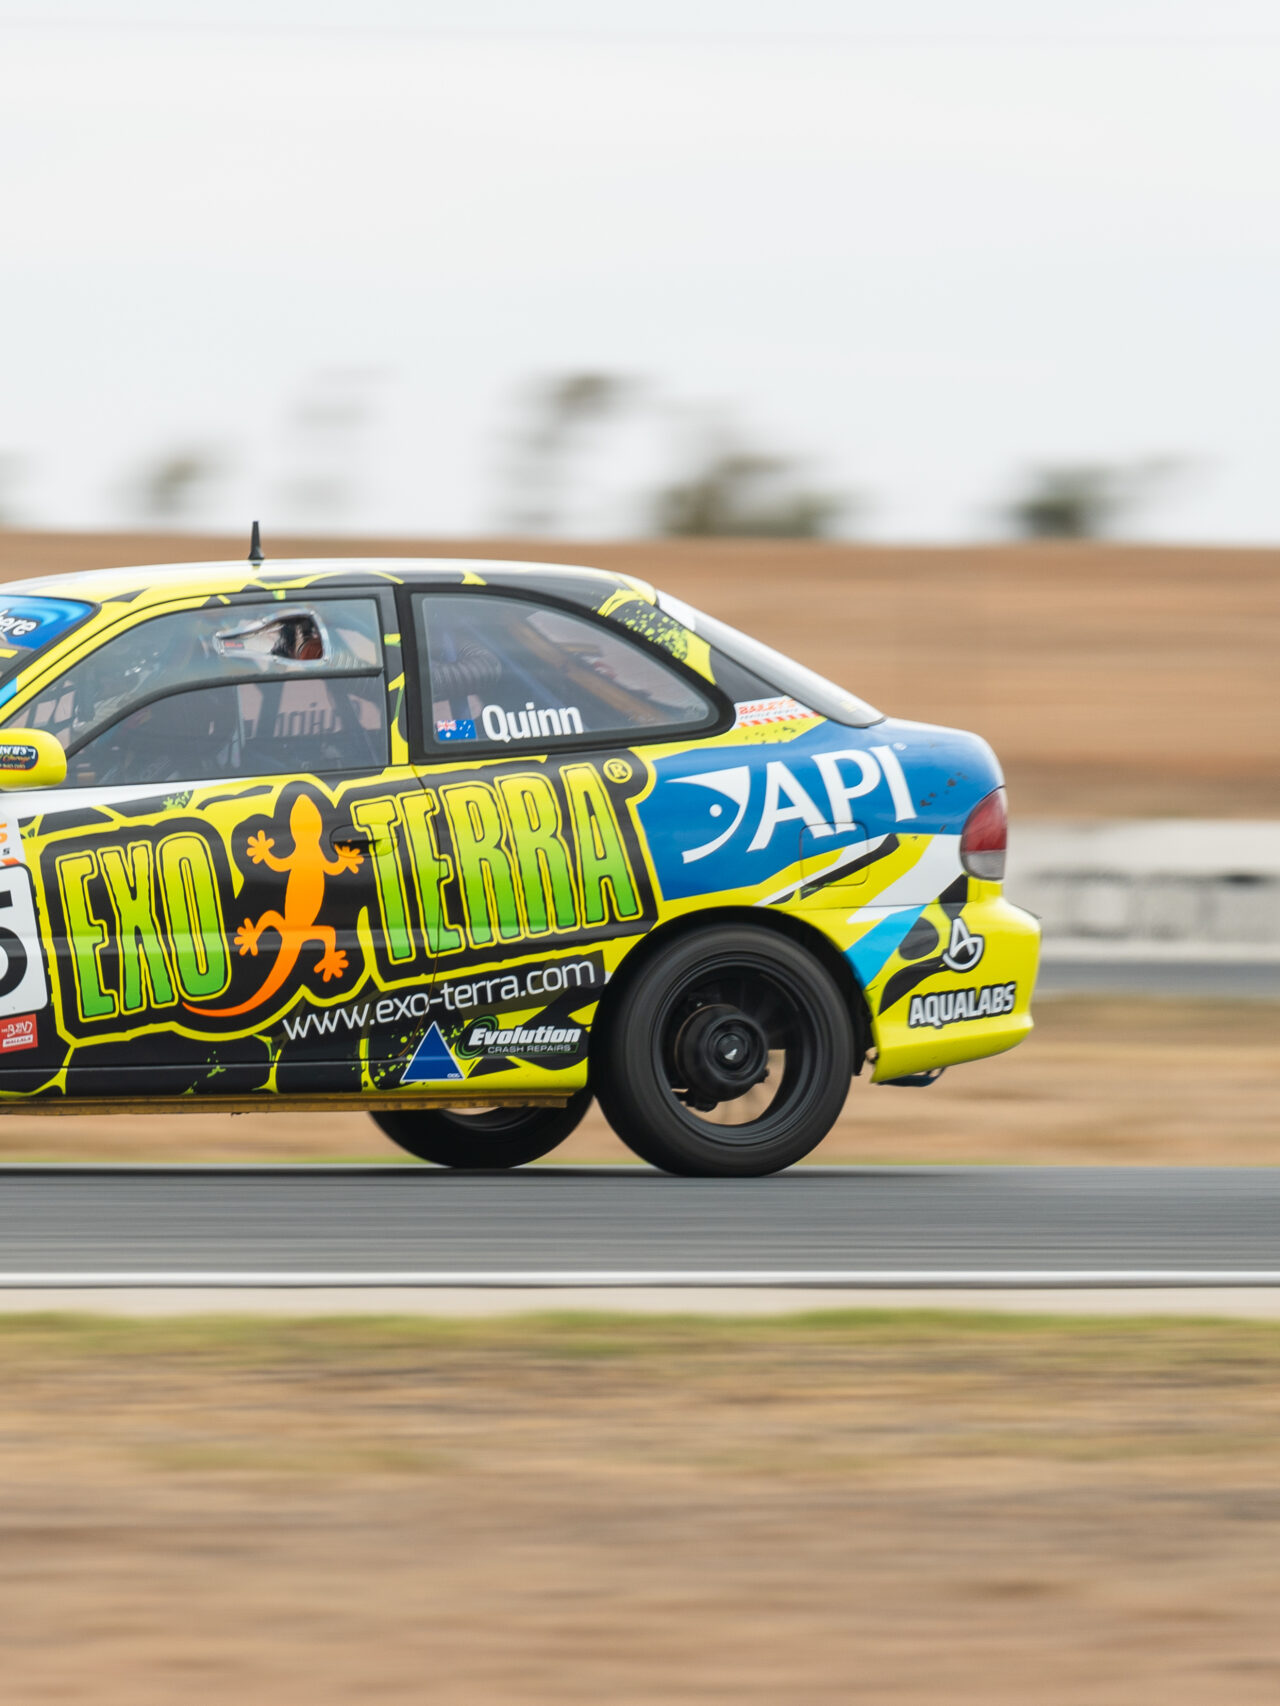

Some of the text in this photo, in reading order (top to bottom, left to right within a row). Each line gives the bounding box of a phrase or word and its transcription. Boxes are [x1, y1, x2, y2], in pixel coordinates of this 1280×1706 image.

[482, 702, 583, 743] Quinn
[746, 745, 917, 853] API
[55, 831, 232, 1023] EXO
[282, 959, 596, 1041] www.exo-terra.com
[908, 981, 1017, 1029] AQUALABS
[468, 1026, 582, 1046] Evolution
[487, 1044, 572, 1054] CRASH REPAIRS
